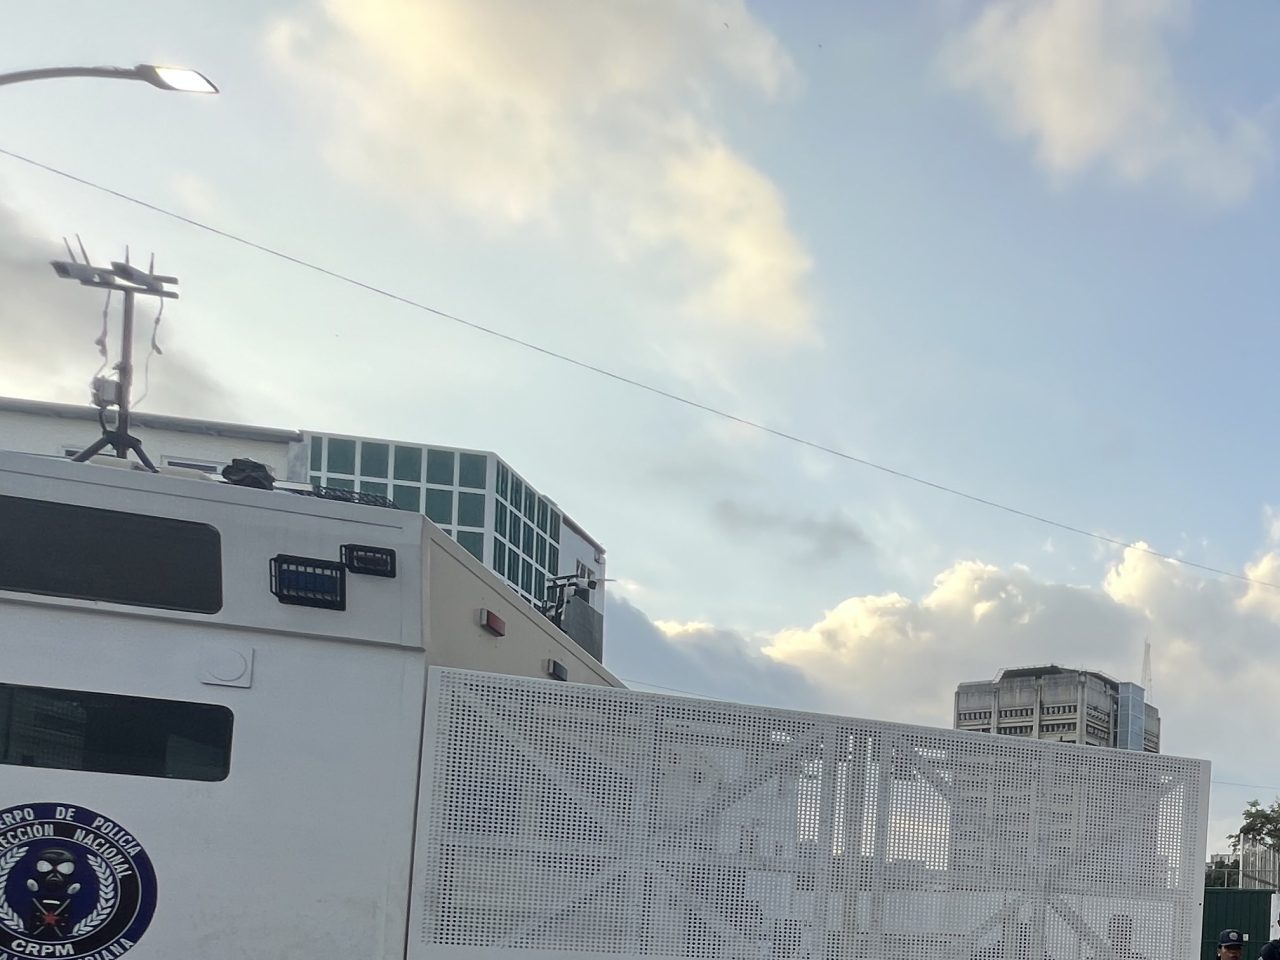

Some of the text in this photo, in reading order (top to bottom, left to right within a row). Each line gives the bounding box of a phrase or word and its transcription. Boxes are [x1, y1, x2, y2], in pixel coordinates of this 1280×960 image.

[0, 808, 35, 828] RPO
[55, 806, 77, 821] DE
[0, 821, 133, 879] ECCIÓN NACIONAL
[11, 939, 75, 957] CRPM
